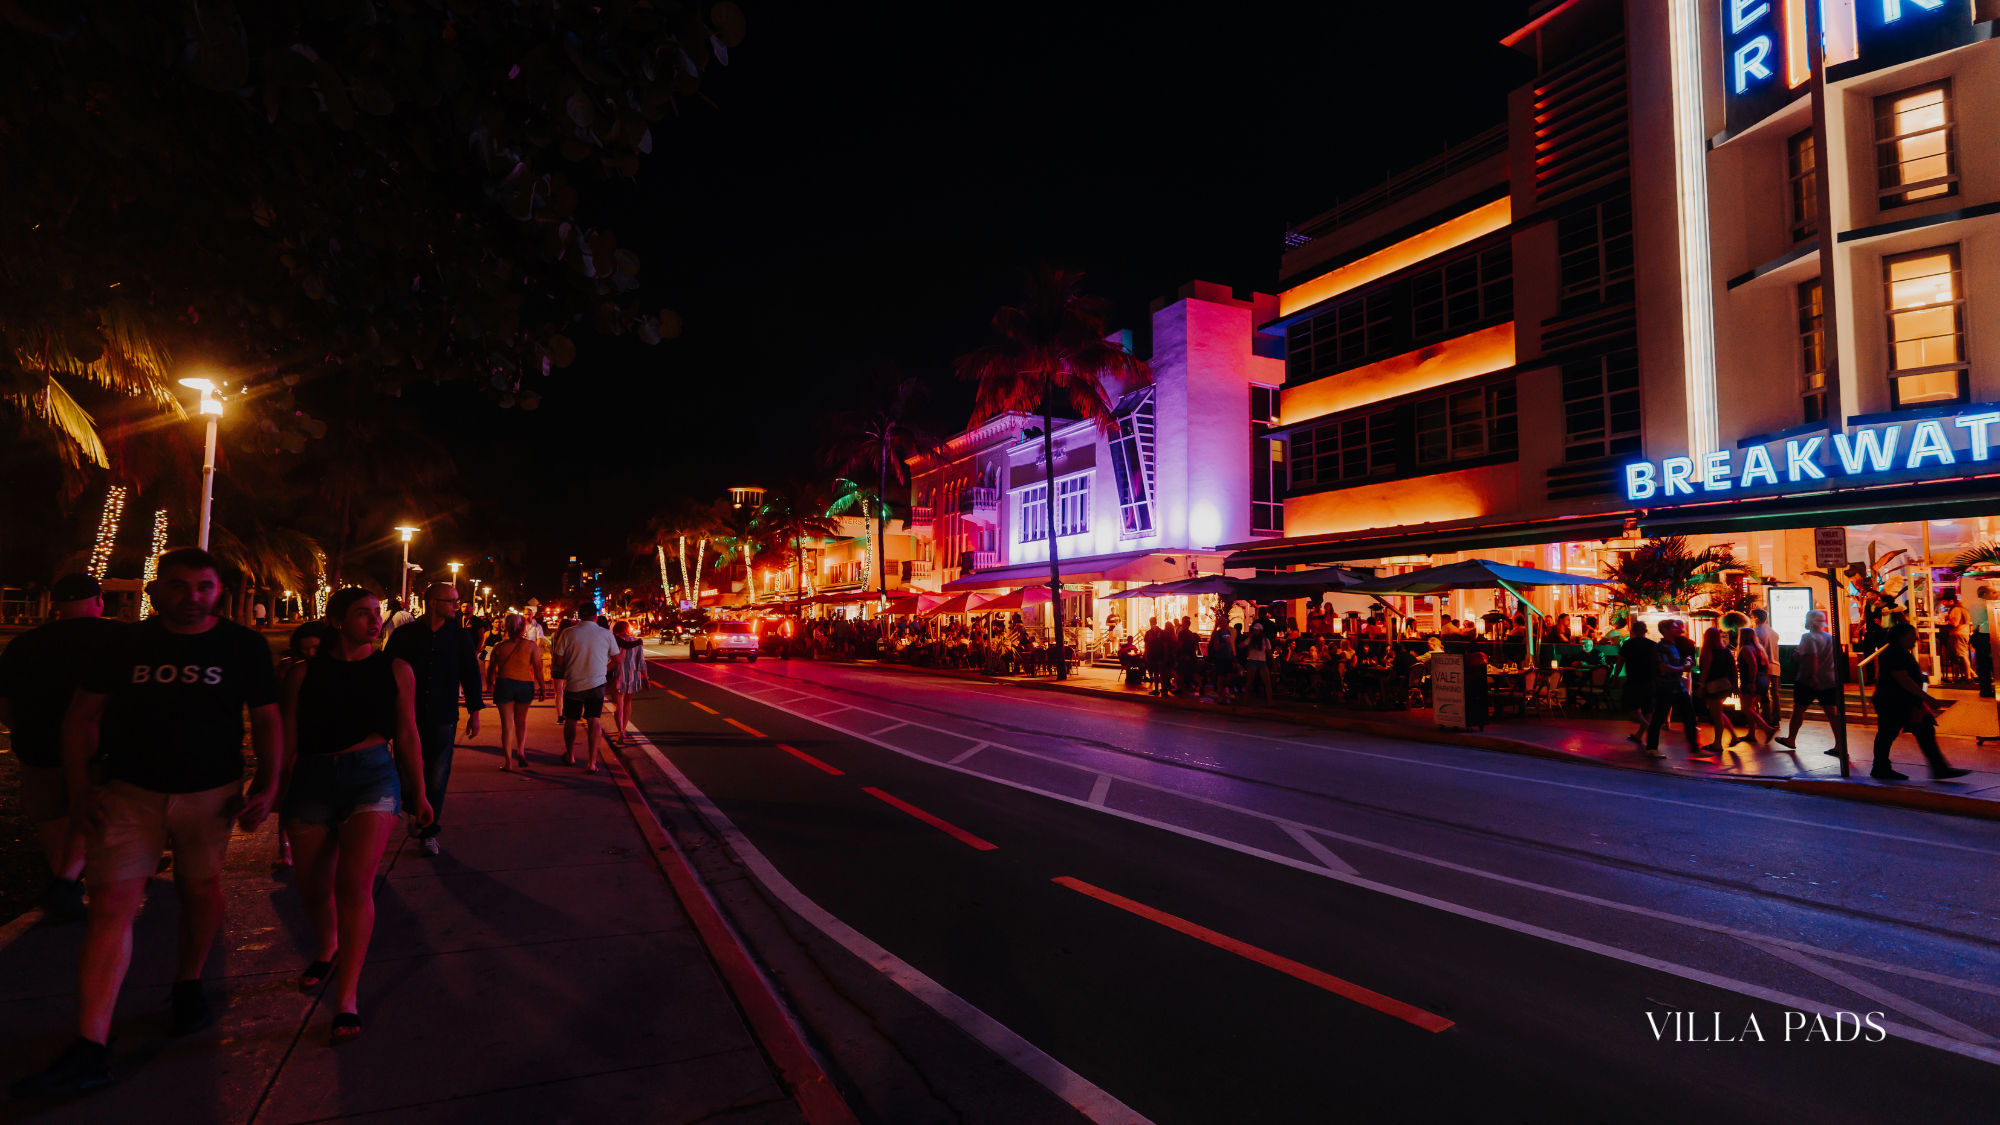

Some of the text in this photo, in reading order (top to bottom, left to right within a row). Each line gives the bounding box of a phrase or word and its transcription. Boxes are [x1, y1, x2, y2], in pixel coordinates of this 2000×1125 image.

[1625, 412, 2000, 500] BREAKWAT
[1434, 657, 1461, 666] WELCOME
[131, 664, 223, 685] BOSS
[1434, 671, 1461, 684] VALET
[1435, 684, 1461, 694] PARKING
